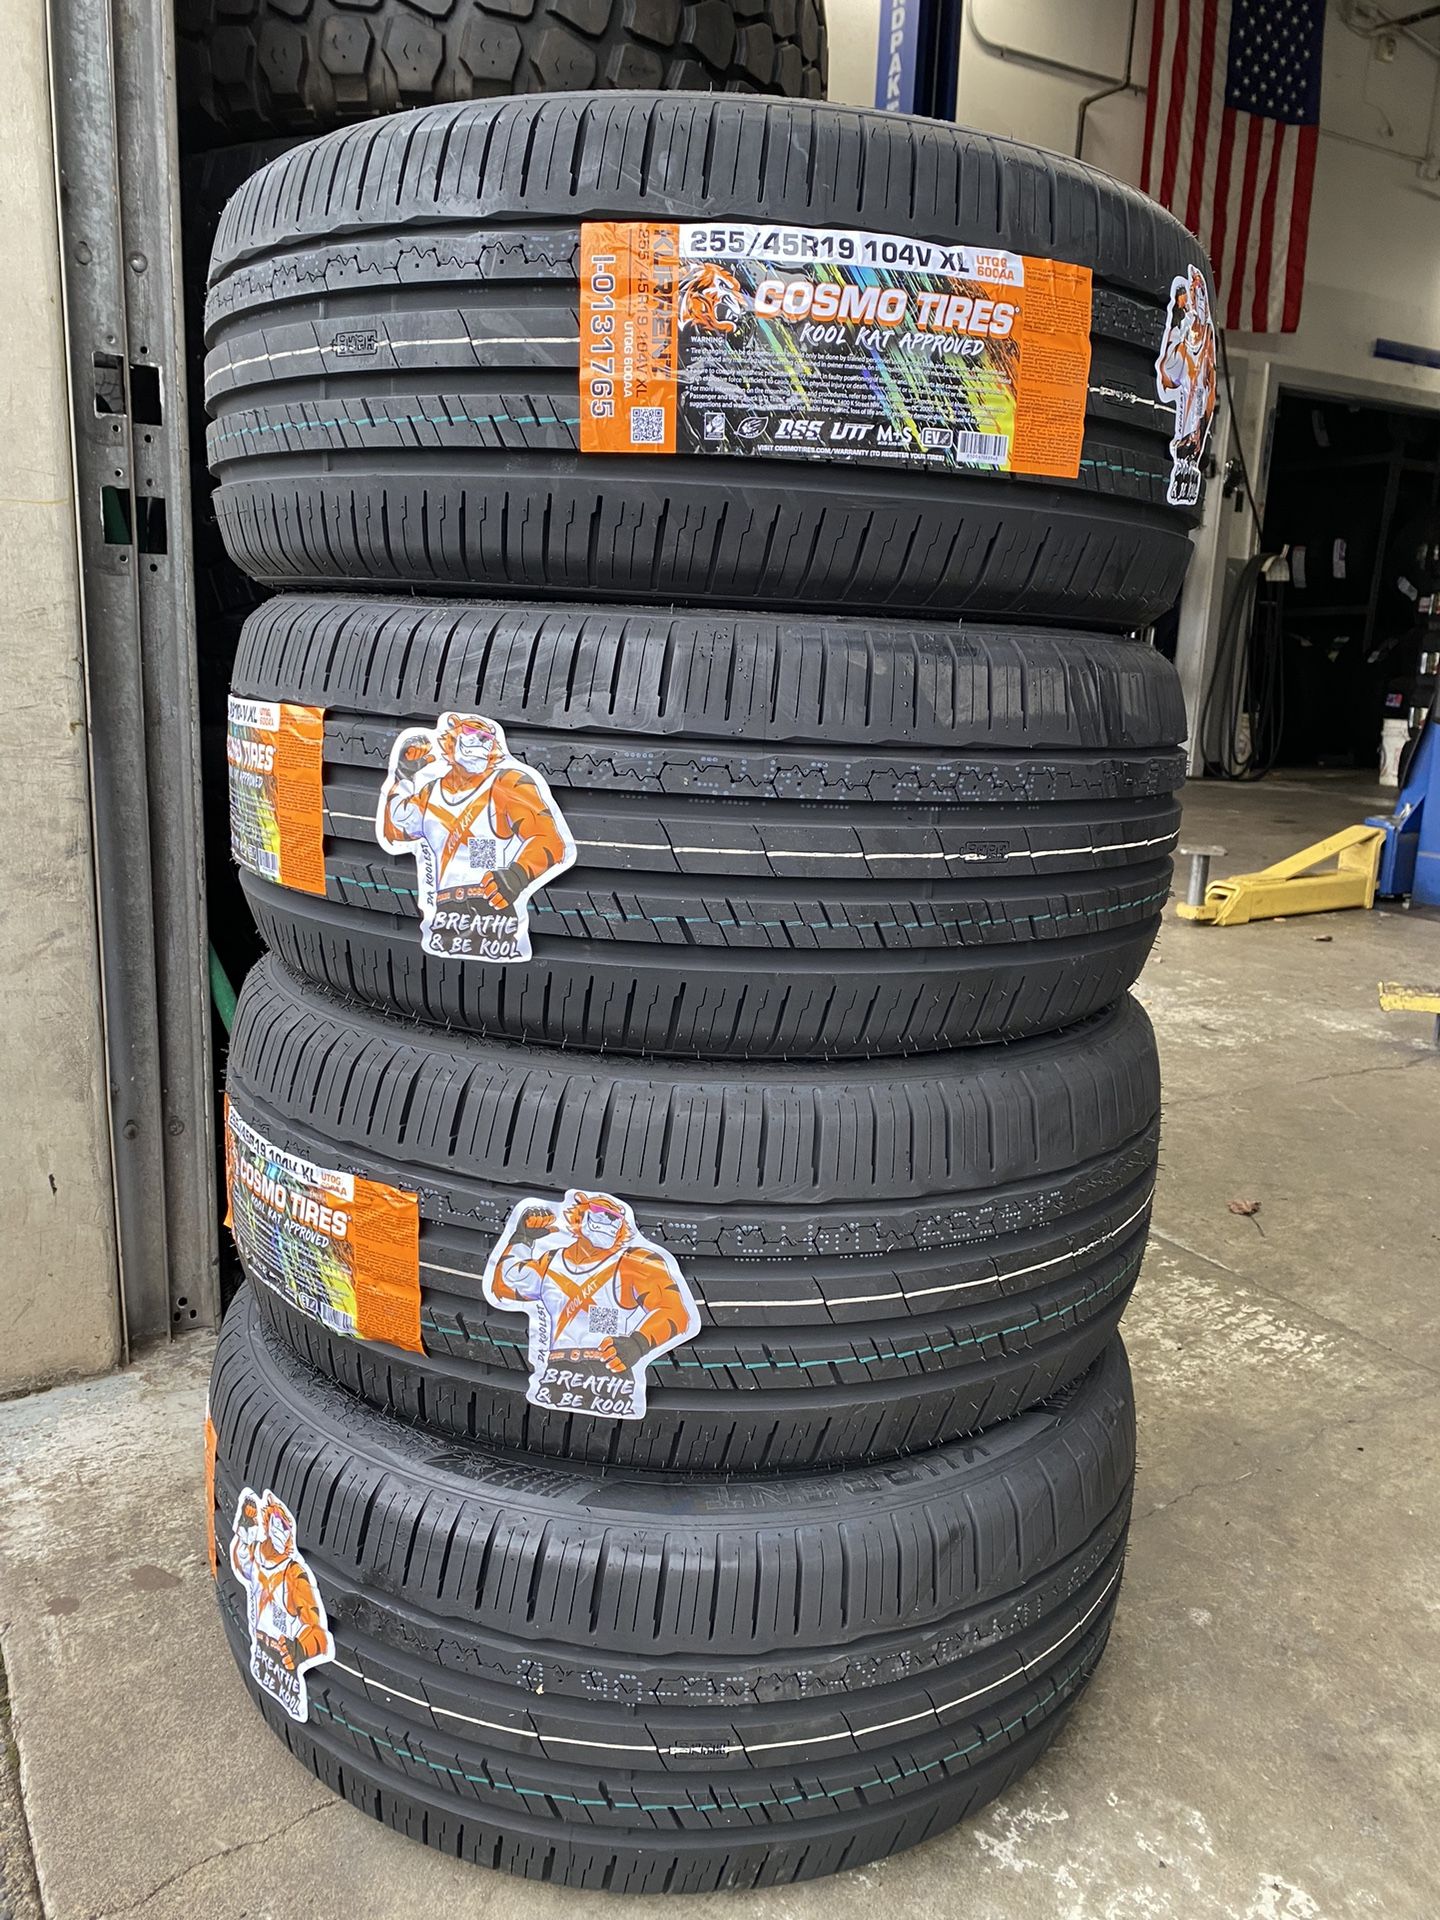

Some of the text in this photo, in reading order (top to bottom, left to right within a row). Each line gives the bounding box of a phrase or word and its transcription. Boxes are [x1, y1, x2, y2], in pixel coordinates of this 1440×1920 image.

[691, 230, 969, 273] 255/45R19 104V XL
[977, 267, 1015, 281] 600AA
[635, 229, 650, 398] 255/45R19 104V XL
[651, 230, 673, 380] KURRENT
[755, 280, 907, 325] COSMO
[915, 291, 1016, 339] TIRES
[591, 254, 616, 419] I-0131765
[800, 322, 985, 356] KOOL KAT APPROVED
[624, 321, 634, 398] UTQG 600AA
[840, 354, 847, 362] by
[757, 444, 774, 452] VISIT
[876, 425, 913, 443] M+S
[924, 430, 940, 444] EV
[459, 808, 476, 831] KAT
[420, 841, 434, 887] KOOLEST
[431, 910, 519, 938] BREATHE
[430, 933, 522, 958] & BE KOOL
[300, 1166, 319, 1185] XL
[240, 1160, 348, 1240] COSMO TIRES
[284, 1218, 330, 1249] APPROVED
[565, 1280, 598, 1317] KOOL KAT
[538, 1304, 551, 1347] KOOLEST
[541, 1368, 635, 1398] BREATHE
[536, 1387, 635, 1415] & BE KOOL
[255, 1645, 300, 1693] BREATHE
[262, 1672, 276, 1690] BE
[278, 1684, 301, 1717] KOOL
